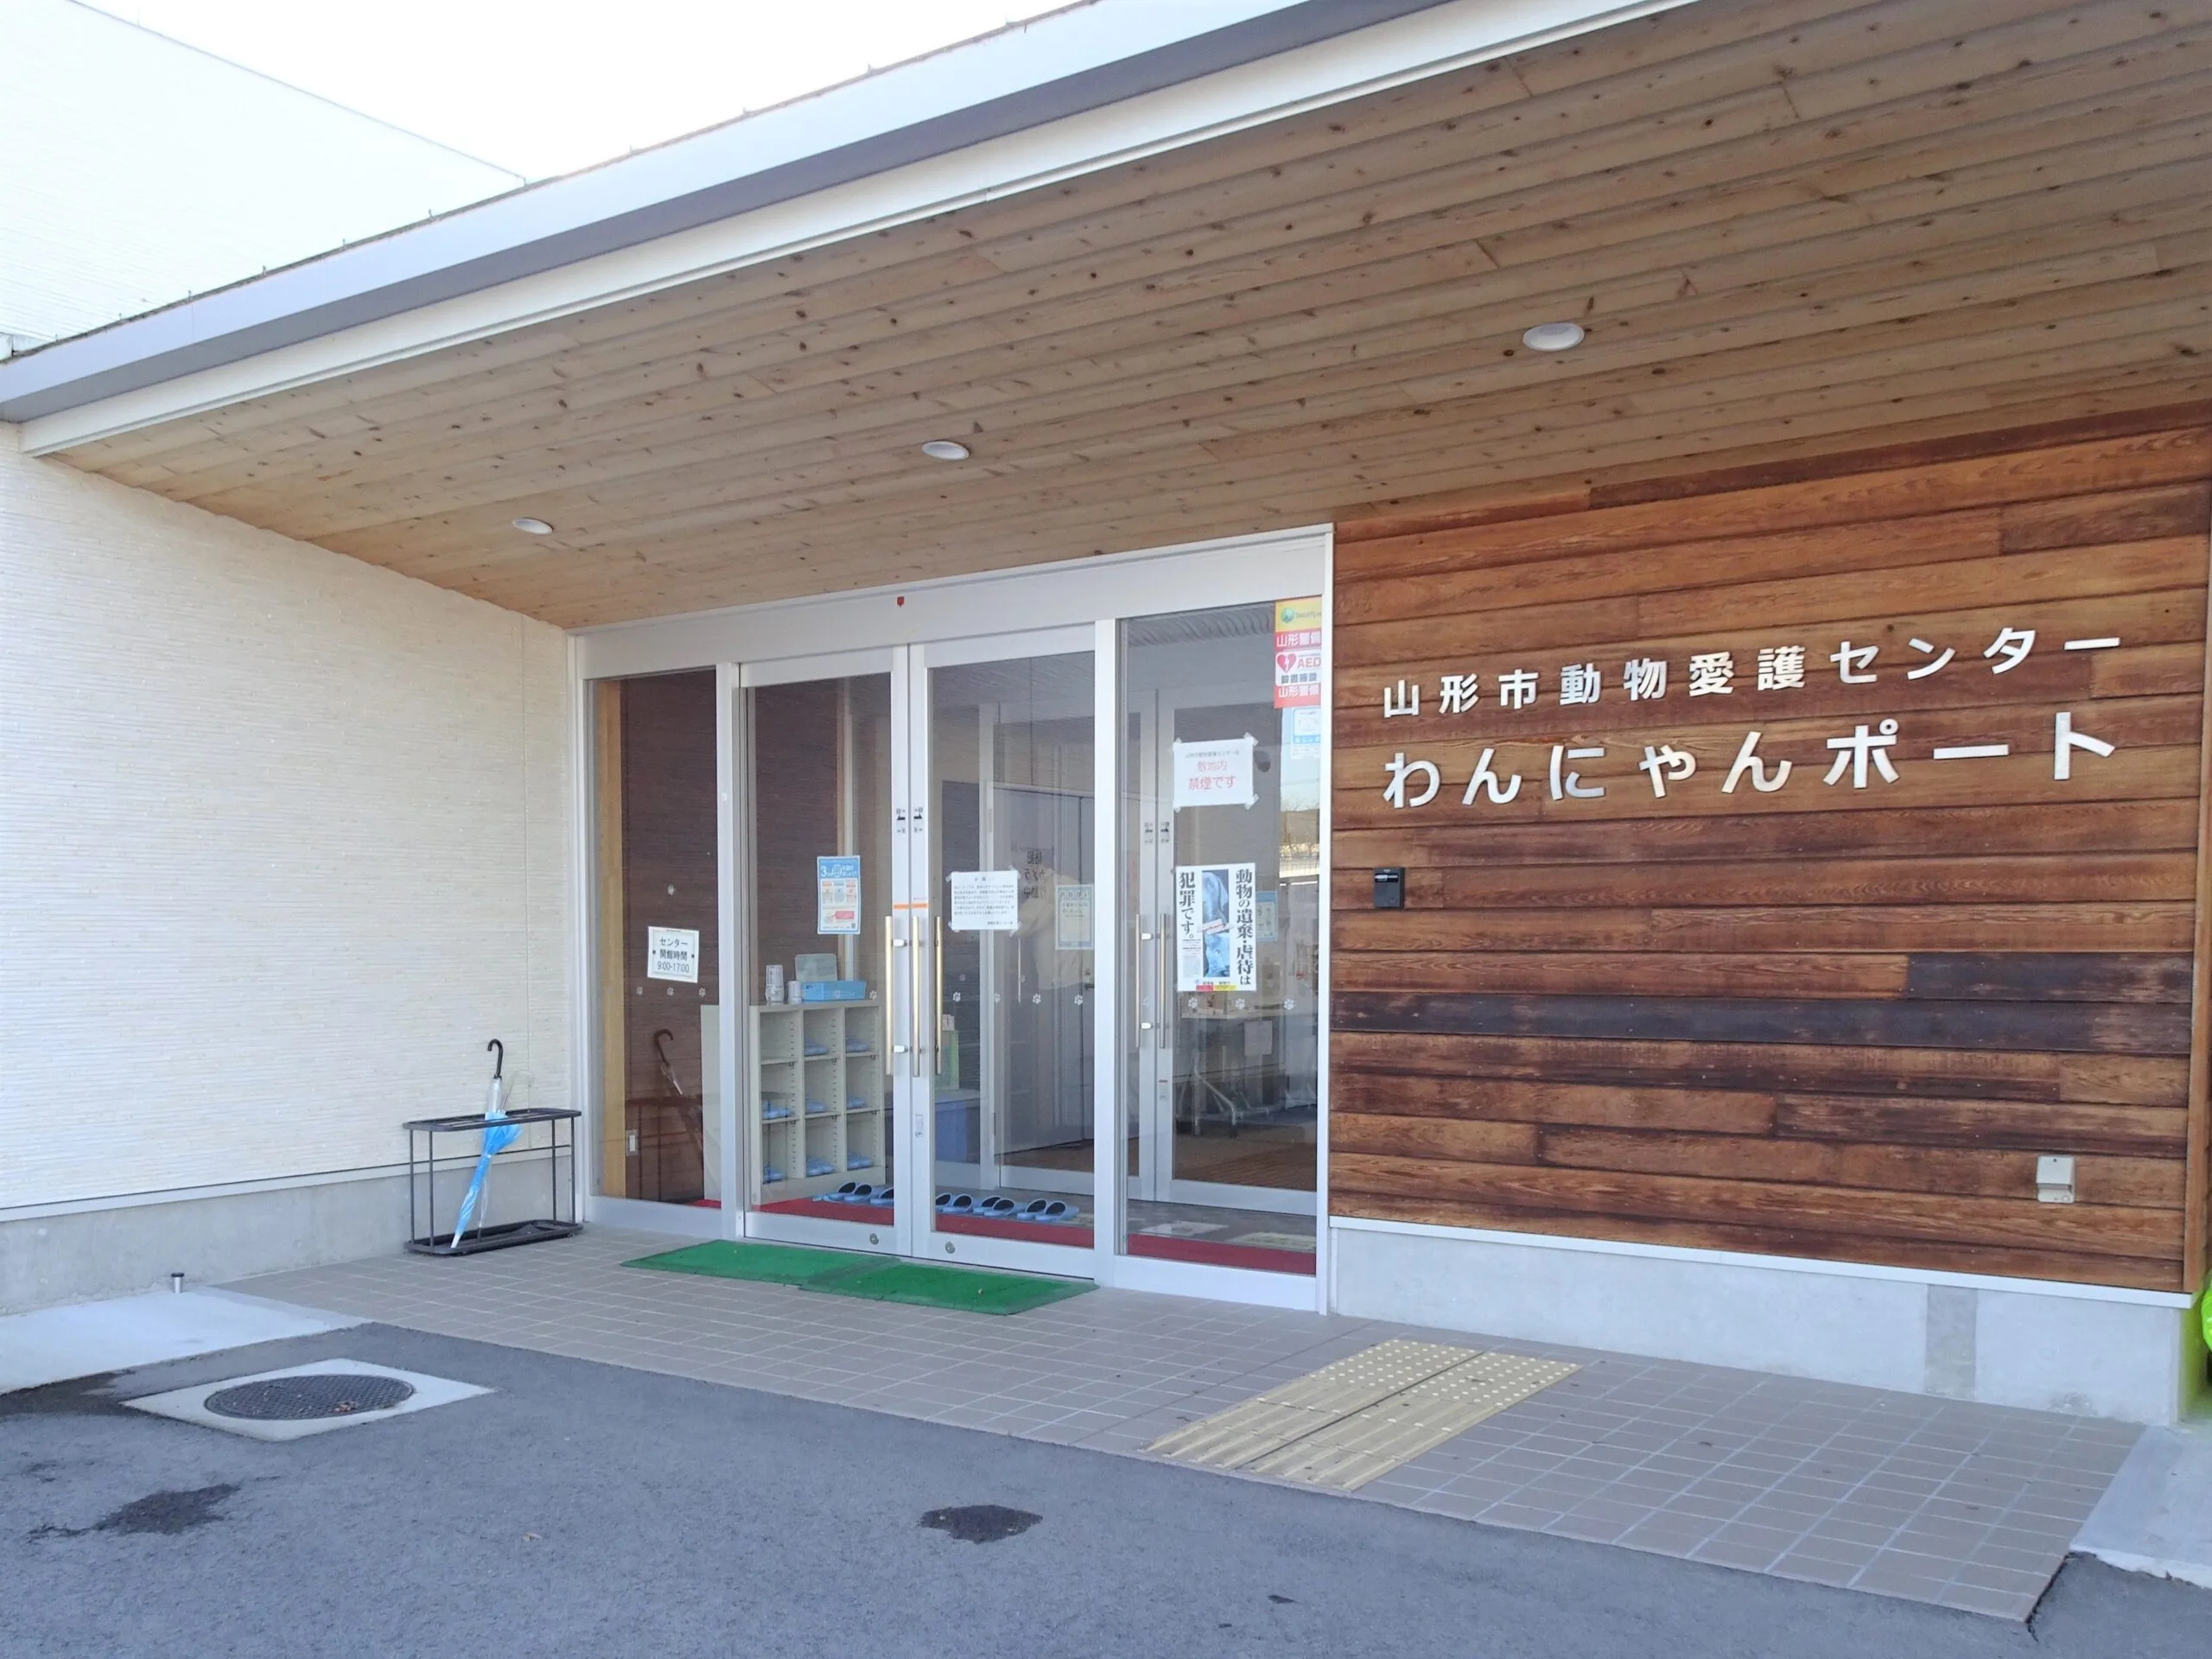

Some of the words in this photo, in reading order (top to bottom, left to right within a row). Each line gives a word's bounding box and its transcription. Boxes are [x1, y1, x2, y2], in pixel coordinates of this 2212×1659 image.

[1297, 657, 1321, 669] AED
[1382, 627, 2121, 718] 山形市動物愛護センター
[1188, 775, 1236, 791] 禁煙です
[1382, 711, 2116, 809] わんにゃんポート
[1179, 872, 1195, 939] 犯罪です。
[1236, 868, 1254, 986] 動物の遺棄・虐待は
[659, 936, 688, 947] センター
